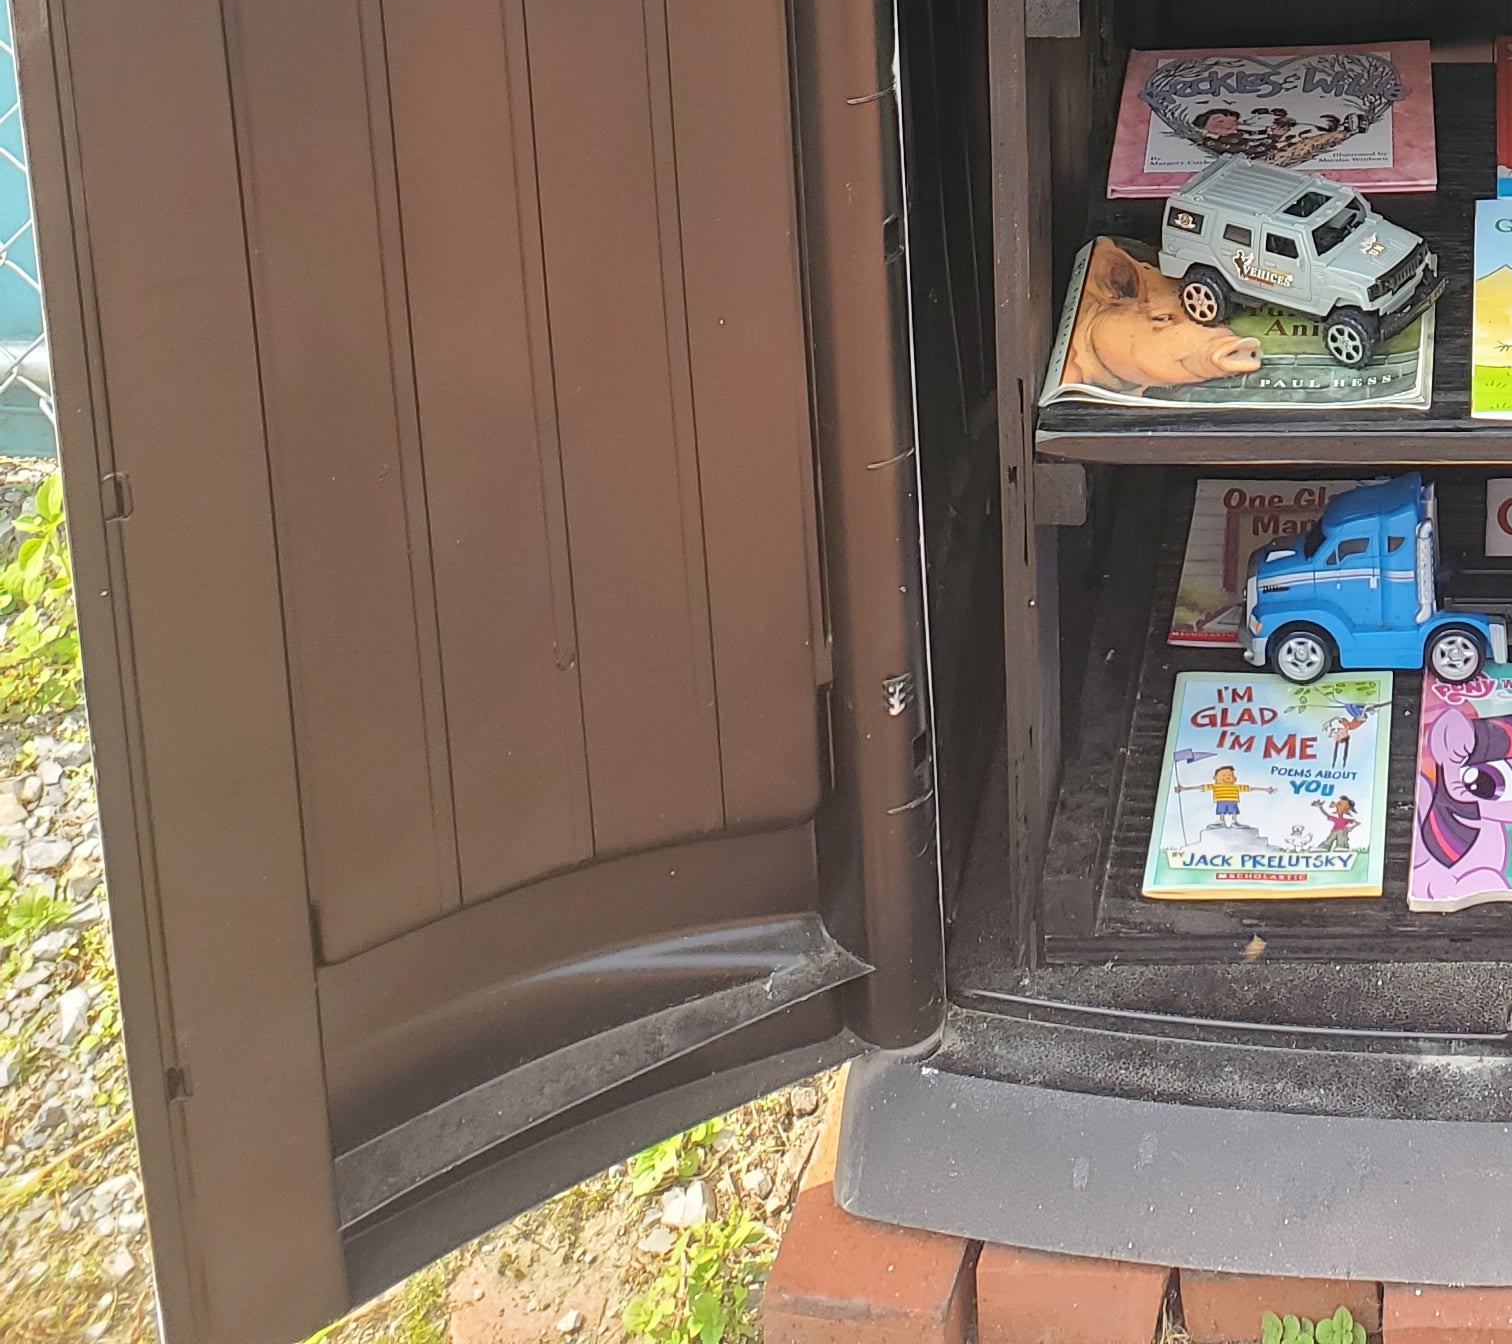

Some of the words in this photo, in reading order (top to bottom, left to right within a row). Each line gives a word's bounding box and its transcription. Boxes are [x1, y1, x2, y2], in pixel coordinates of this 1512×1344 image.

[1242, 263, 1293, 288] VEHICES
[1259, 377, 1321, 388] PAUL
[1332, 375, 1392, 388] HESS
[1217, 686, 1254, 709] I'M
[1434, 679, 1496, 703] PONY
[1190, 706, 1277, 729] GLAD
[1216, 732, 1253, 753] I'M
[1263, 735, 1317, 761] ME
[1271, 766, 1312, 779] POEMS
[1314, 769, 1358, 781] ABOUT
[1289, 779, 1335, 798] YOU
[1182, 851, 1233, 869] JACK
[1239, 852, 1353, 871] PRELUTSKY
